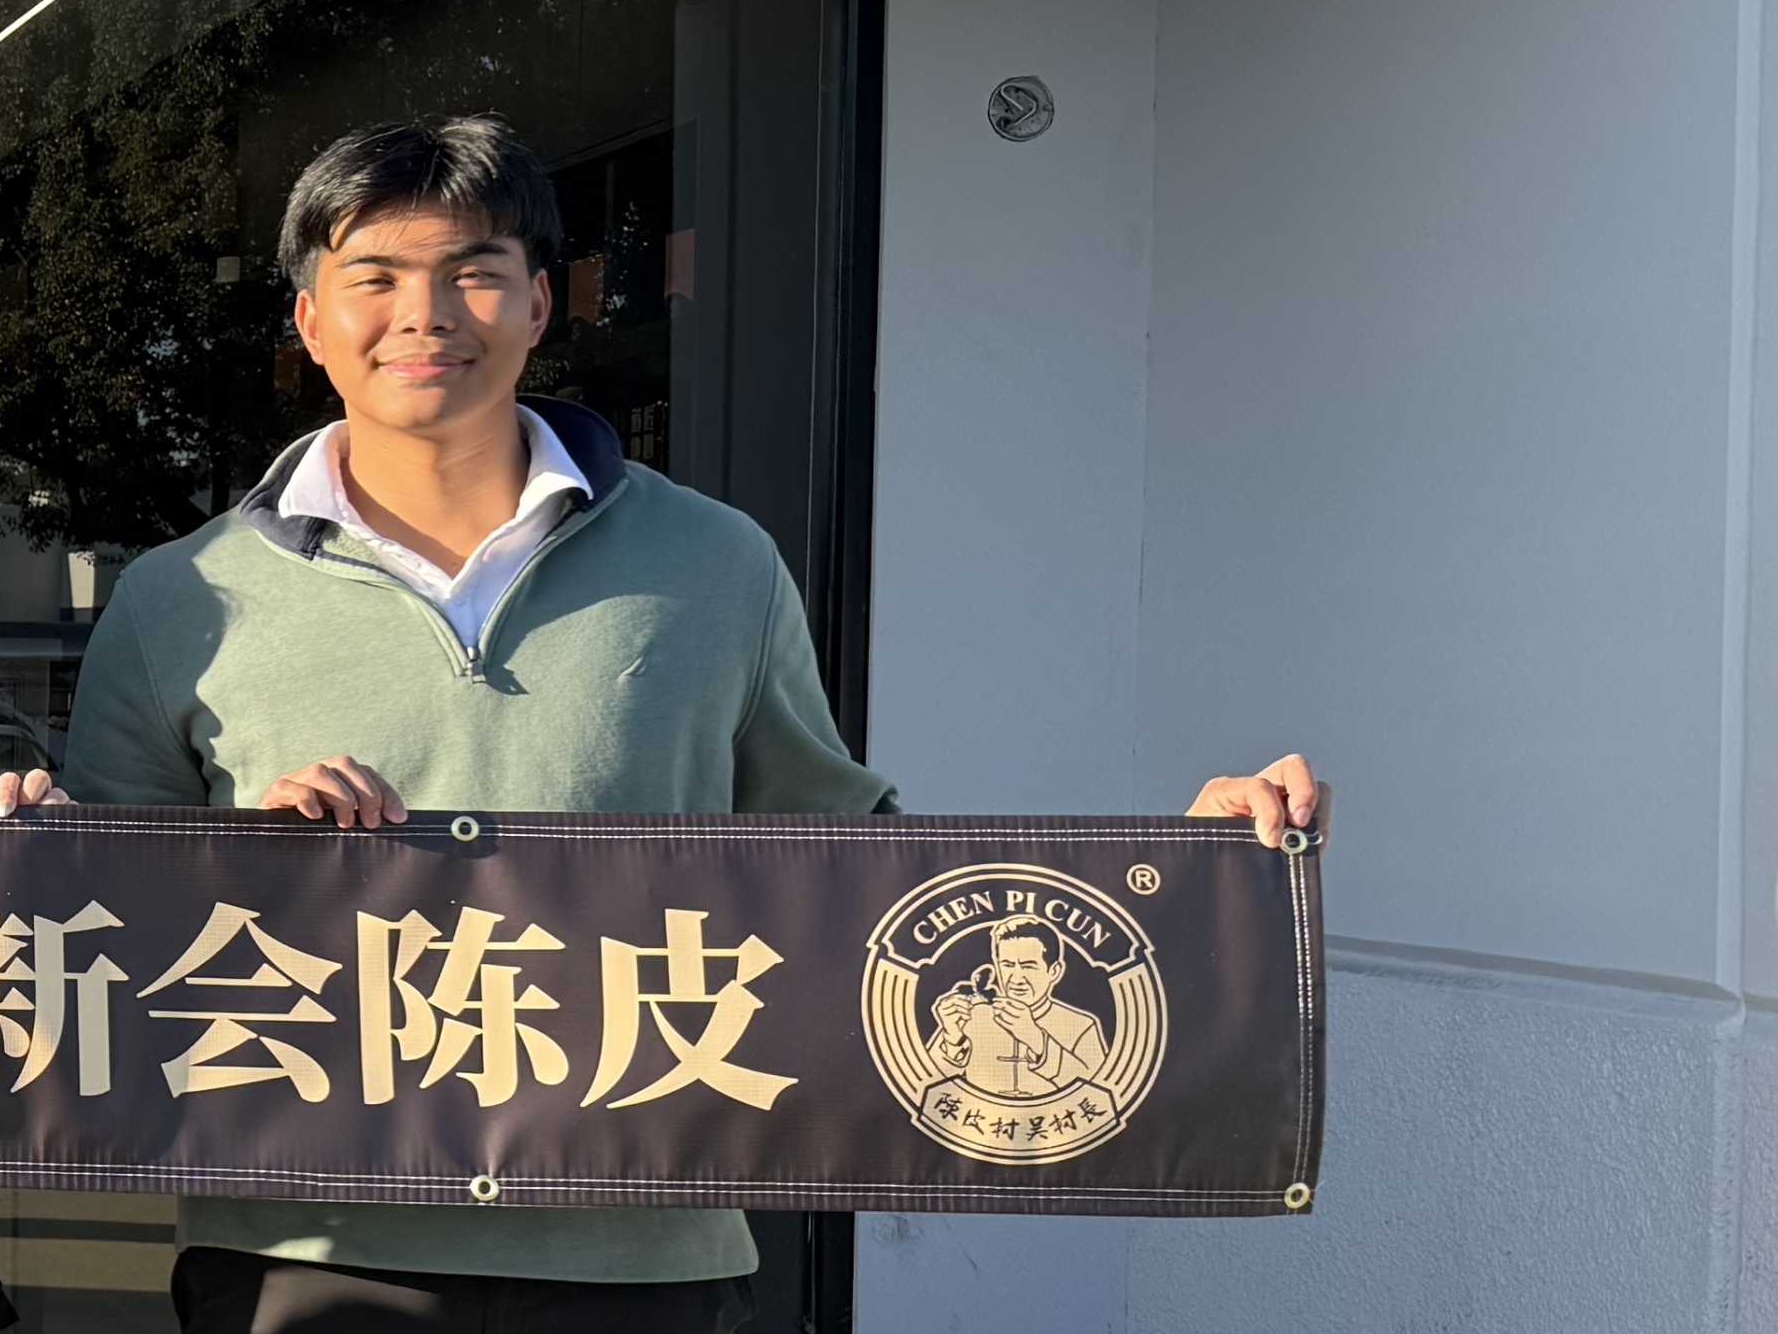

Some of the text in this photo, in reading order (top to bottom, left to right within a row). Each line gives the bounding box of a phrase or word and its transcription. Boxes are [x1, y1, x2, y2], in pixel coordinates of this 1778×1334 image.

[913, 890, 1111, 949] CHEN PI CUN
